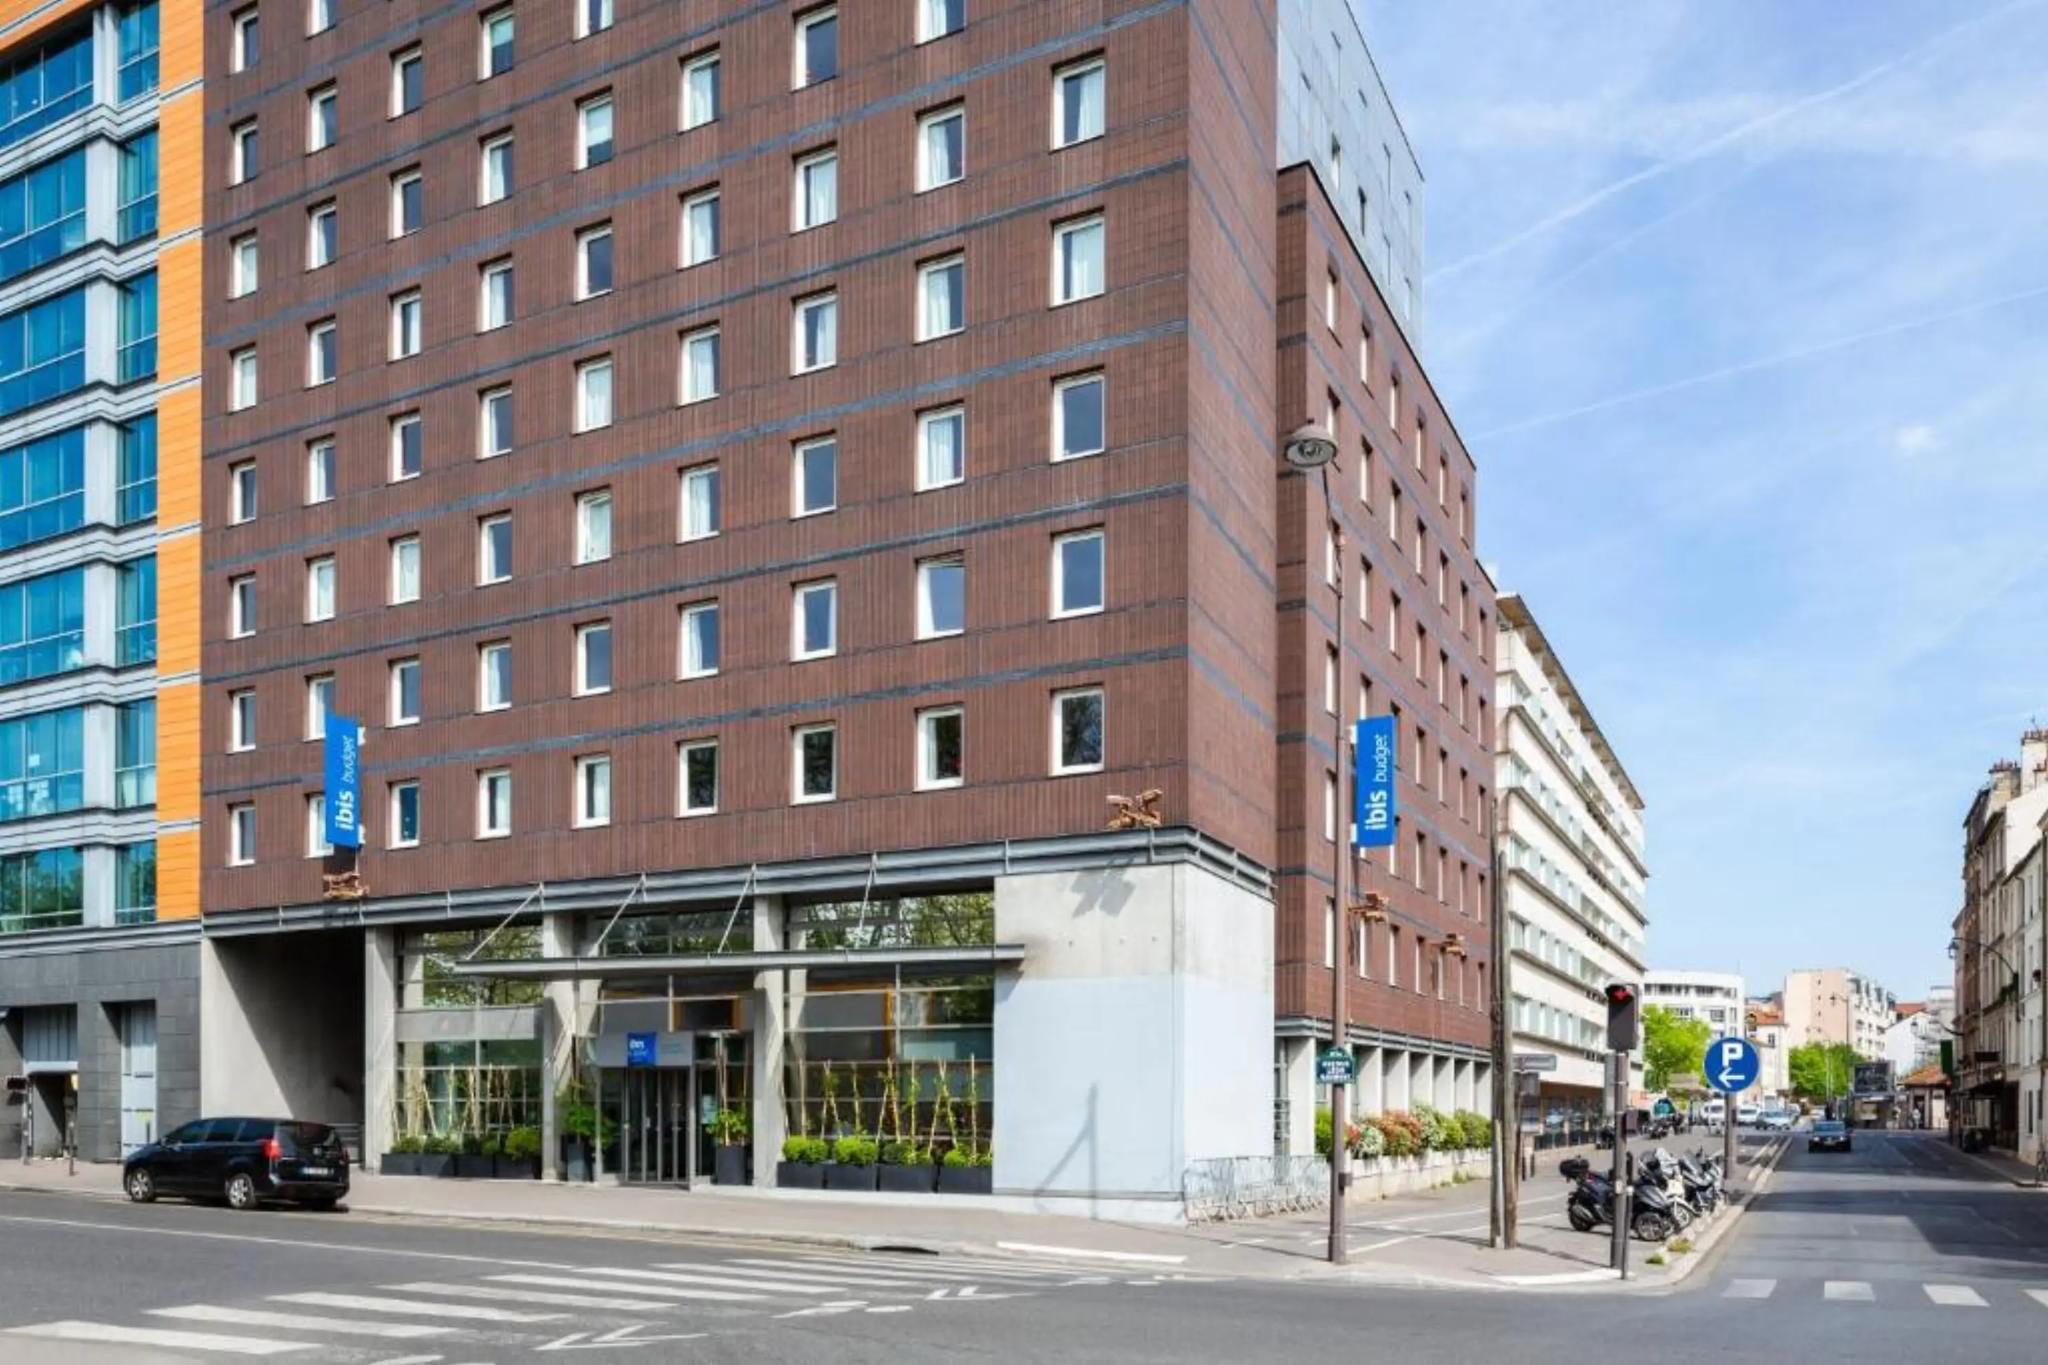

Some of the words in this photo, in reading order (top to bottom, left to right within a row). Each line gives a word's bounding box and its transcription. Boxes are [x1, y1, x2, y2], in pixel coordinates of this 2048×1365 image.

[341, 733, 356, 785] budget
[1373, 733, 1391, 783] budget
[334, 789, 355, 831] ibis
[1364, 789, 1388, 831] ibis
[1722, 1043, 1744, 1068] P
